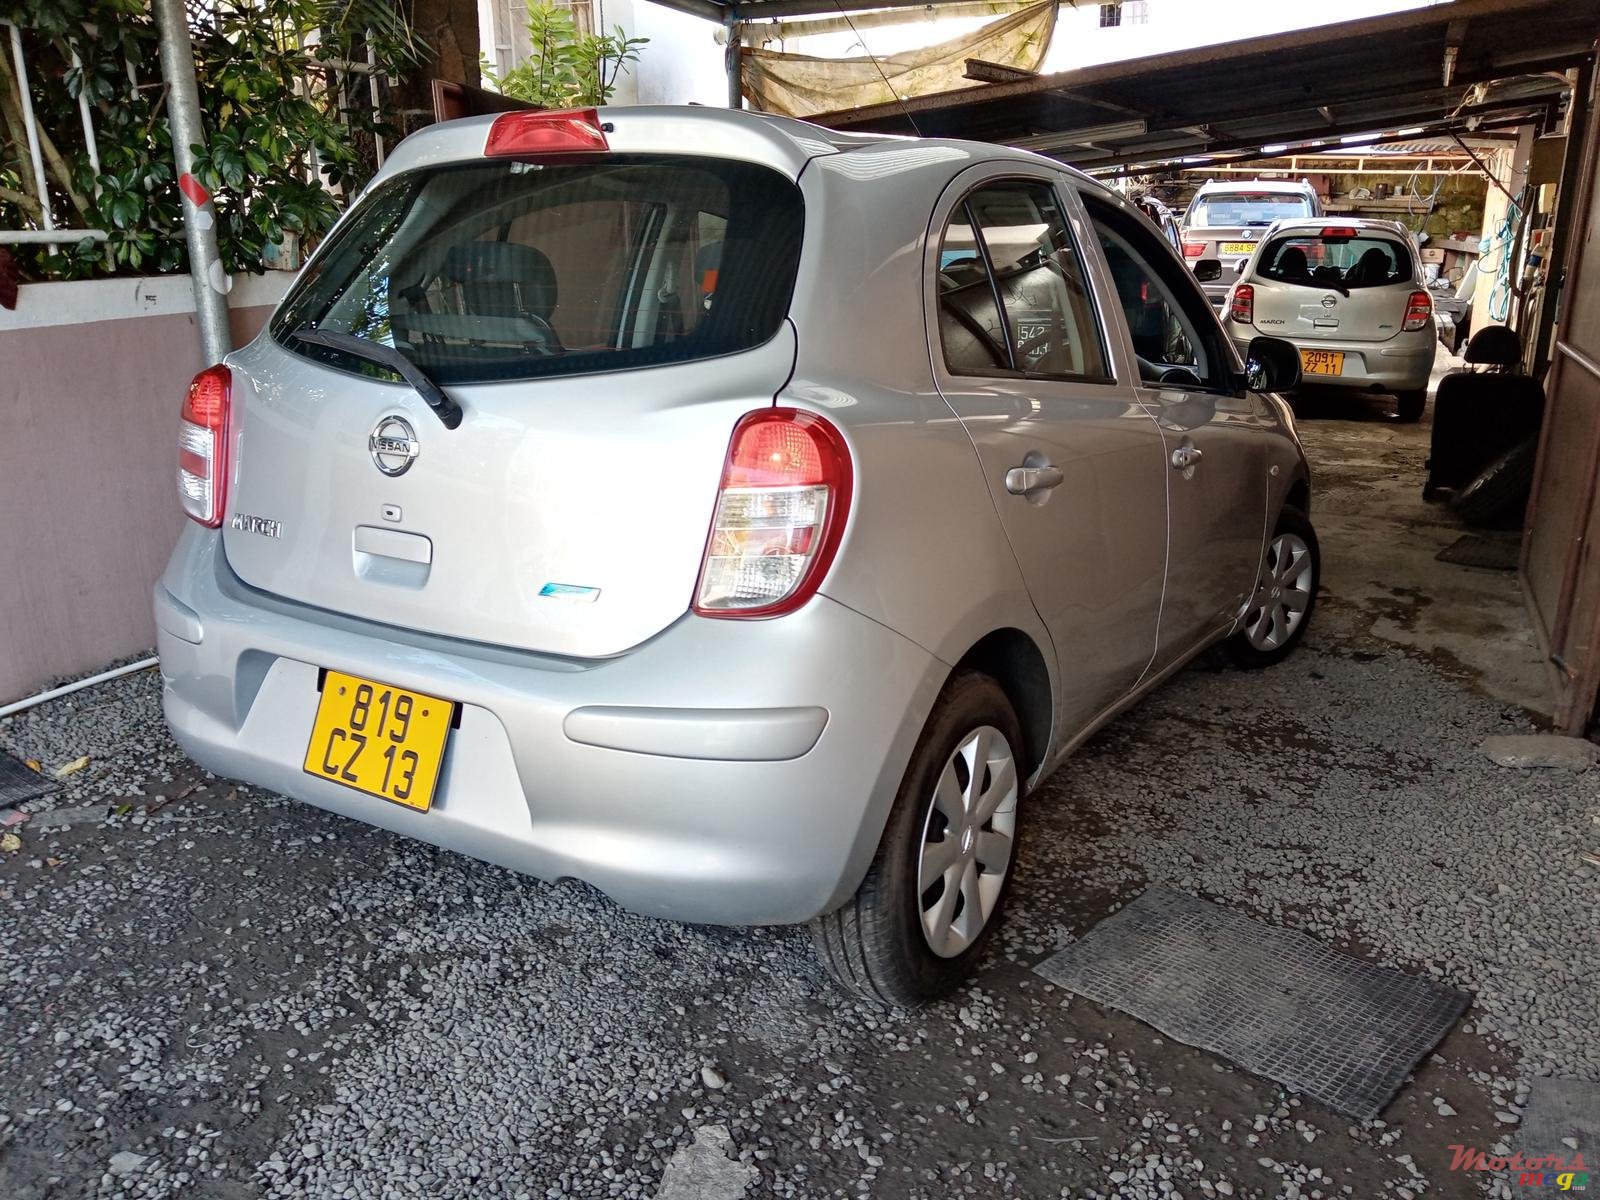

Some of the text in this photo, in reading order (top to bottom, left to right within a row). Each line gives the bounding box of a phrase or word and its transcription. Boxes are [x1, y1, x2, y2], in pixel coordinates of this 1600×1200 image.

[1304, 362, 1336, 374] ZZ 11
[1307, 352, 1335, 363] 2091
[371, 437, 411, 453] NISSAN
[231, 513, 283, 539] MARCH
[350, 684, 413, 743] 819
[323, 728, 419, 799] CZ 13
